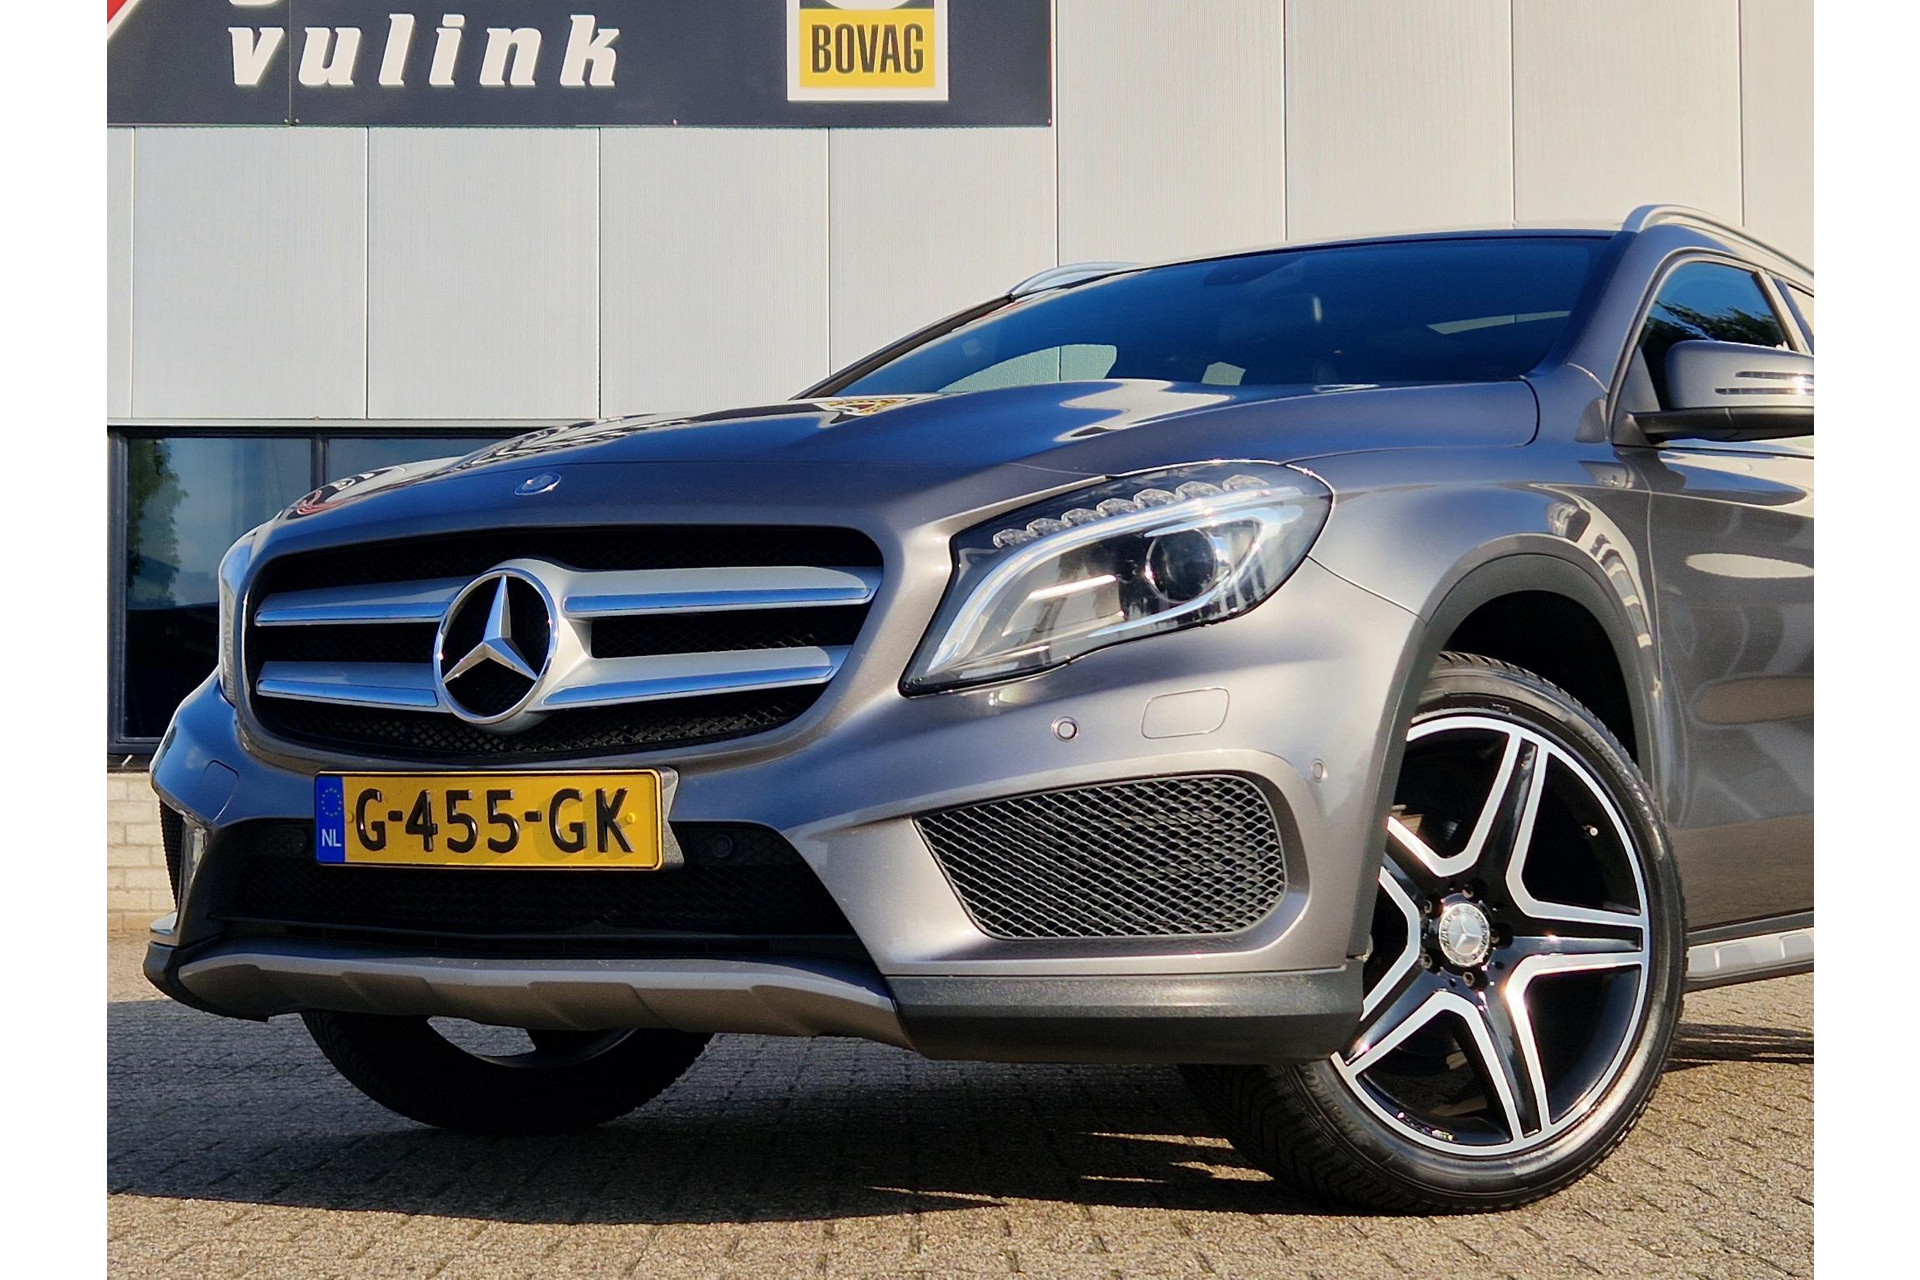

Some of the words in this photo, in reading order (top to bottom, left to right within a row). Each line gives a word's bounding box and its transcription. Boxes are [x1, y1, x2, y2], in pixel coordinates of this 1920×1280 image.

[228, 13, 620, 87] vulink
[812, 23, 924, 74] BOVAG
[321, 828, 342, 848] NL
[355, 787, 634, 853] G-455-GK
